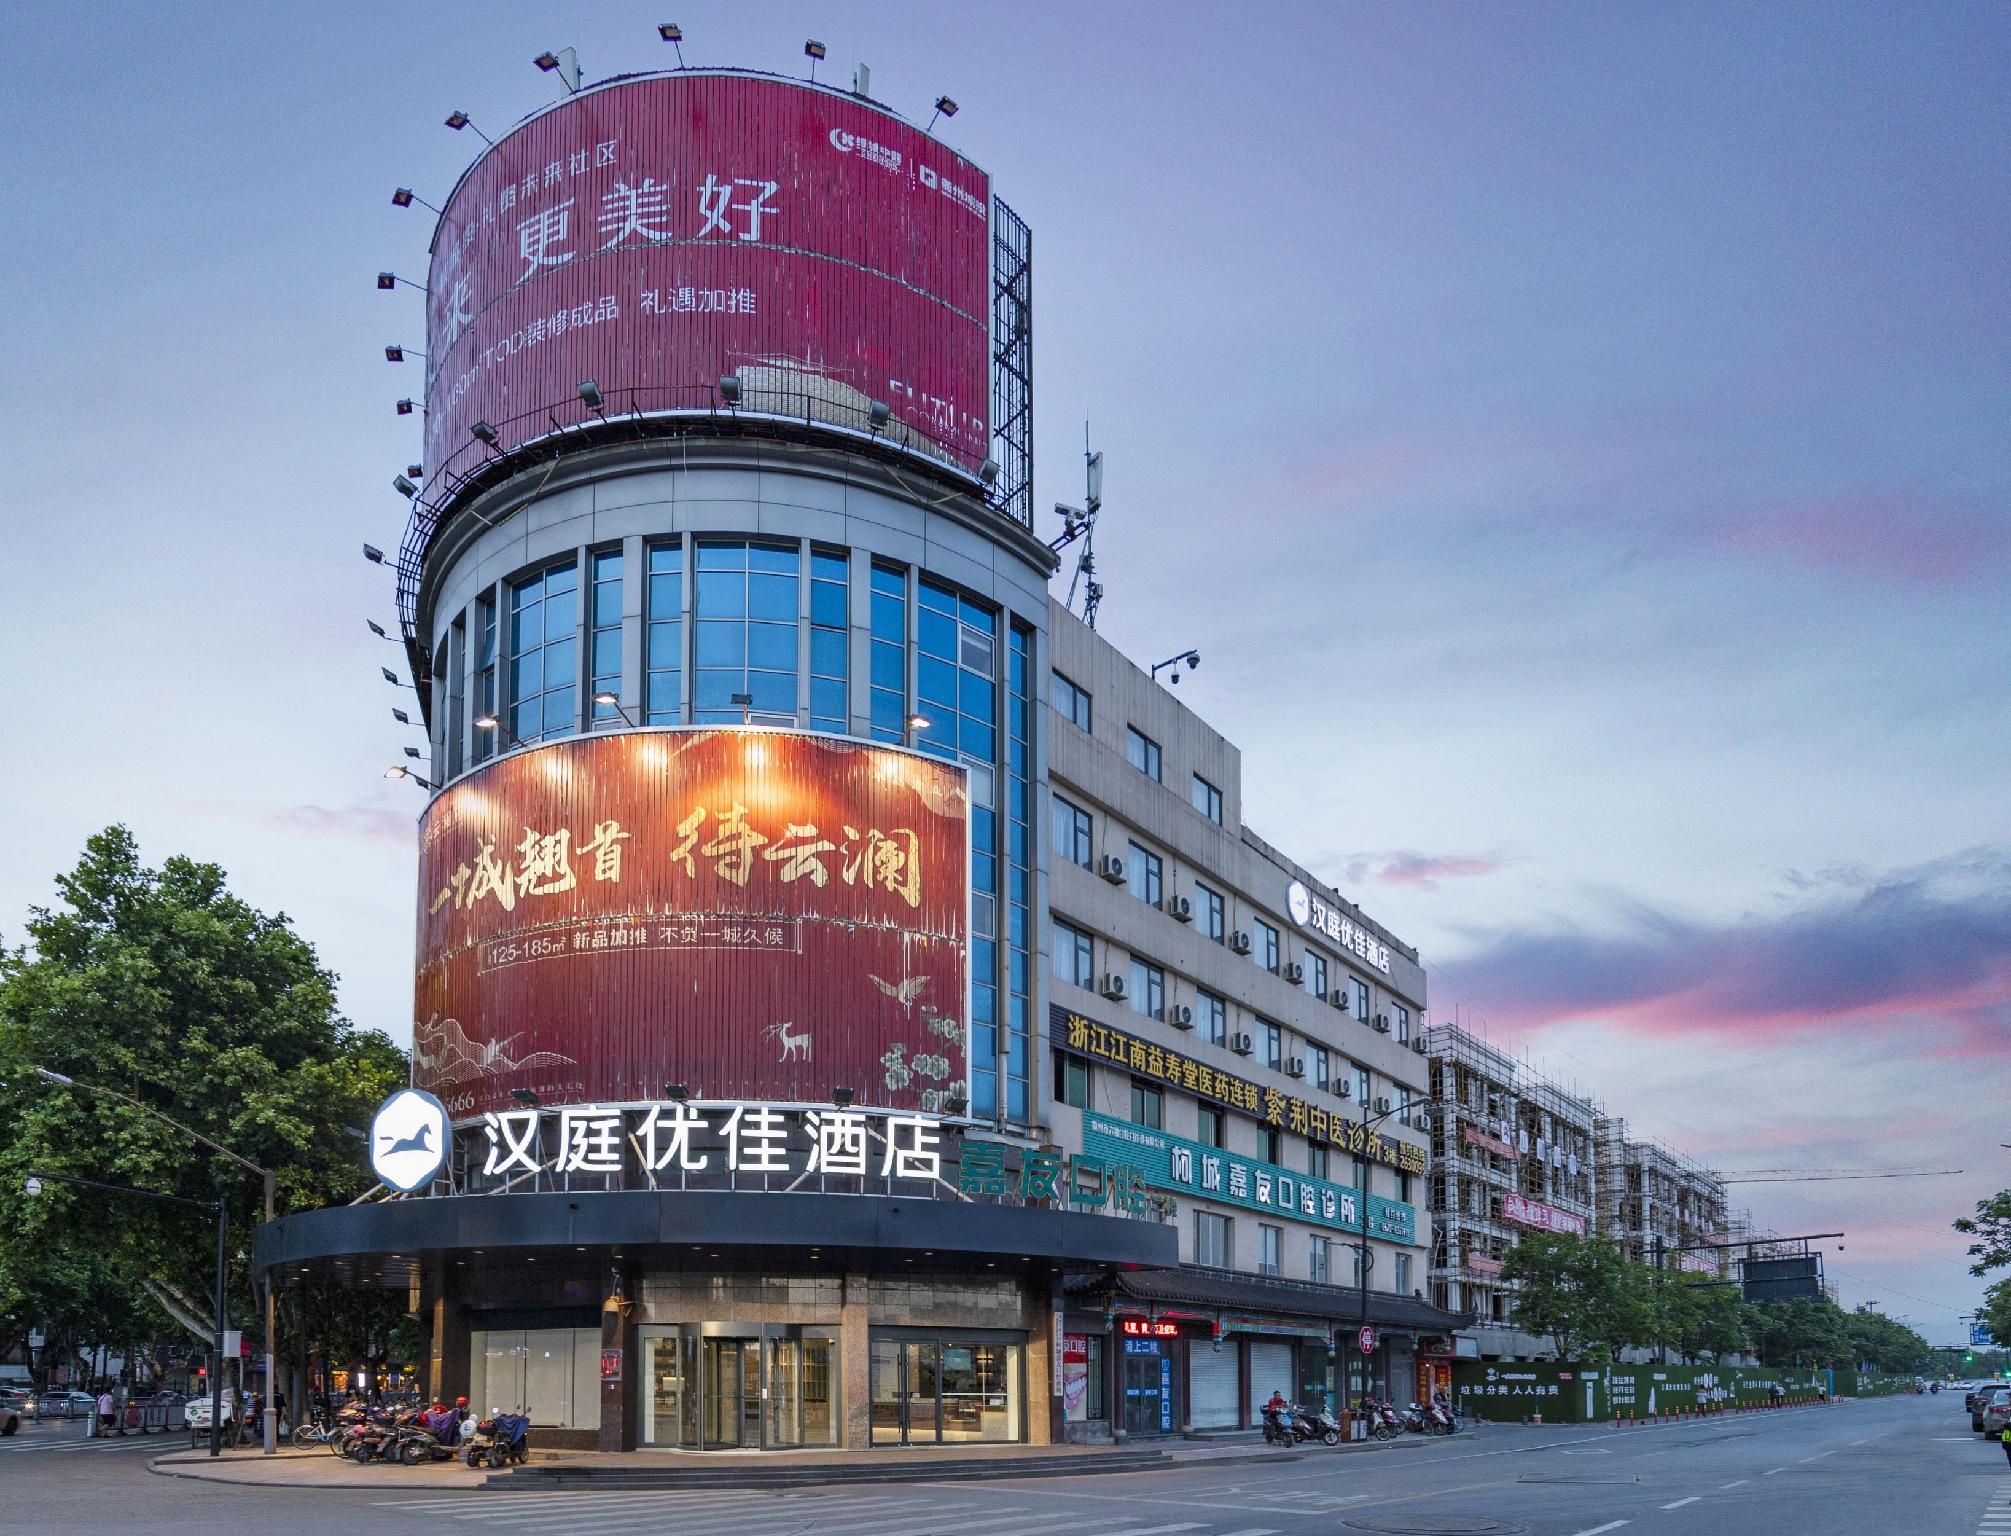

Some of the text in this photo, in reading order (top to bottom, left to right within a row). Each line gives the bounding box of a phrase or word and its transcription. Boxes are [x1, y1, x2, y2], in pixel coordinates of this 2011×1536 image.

[516, 174, 780, 286] 更美好
[640, 287, 757, 315] 礼遇加推
[428, 806, 924, 911] 一城翘首 待云澜
[572, 926, 649, 950] 新品加推
[659, 926, 785, 945] 不负一城久候
[1312, 897, 1390, 974] 汉庭优佳酒店
[1067, 1014, 1382, 1161] 浙江江南益寿堂医药连锁 紫荆中医诊所
[482, 1103, 942, 1179] 汉庭优佳酒店
[959, 1142, 1147, 1214] 嘉友口腔
[1171, 1145, 1356, 1225] 柯城嘉友口腔诊所
[1461, 1385, 1559, 1395] 垃圾分类 人人有责
